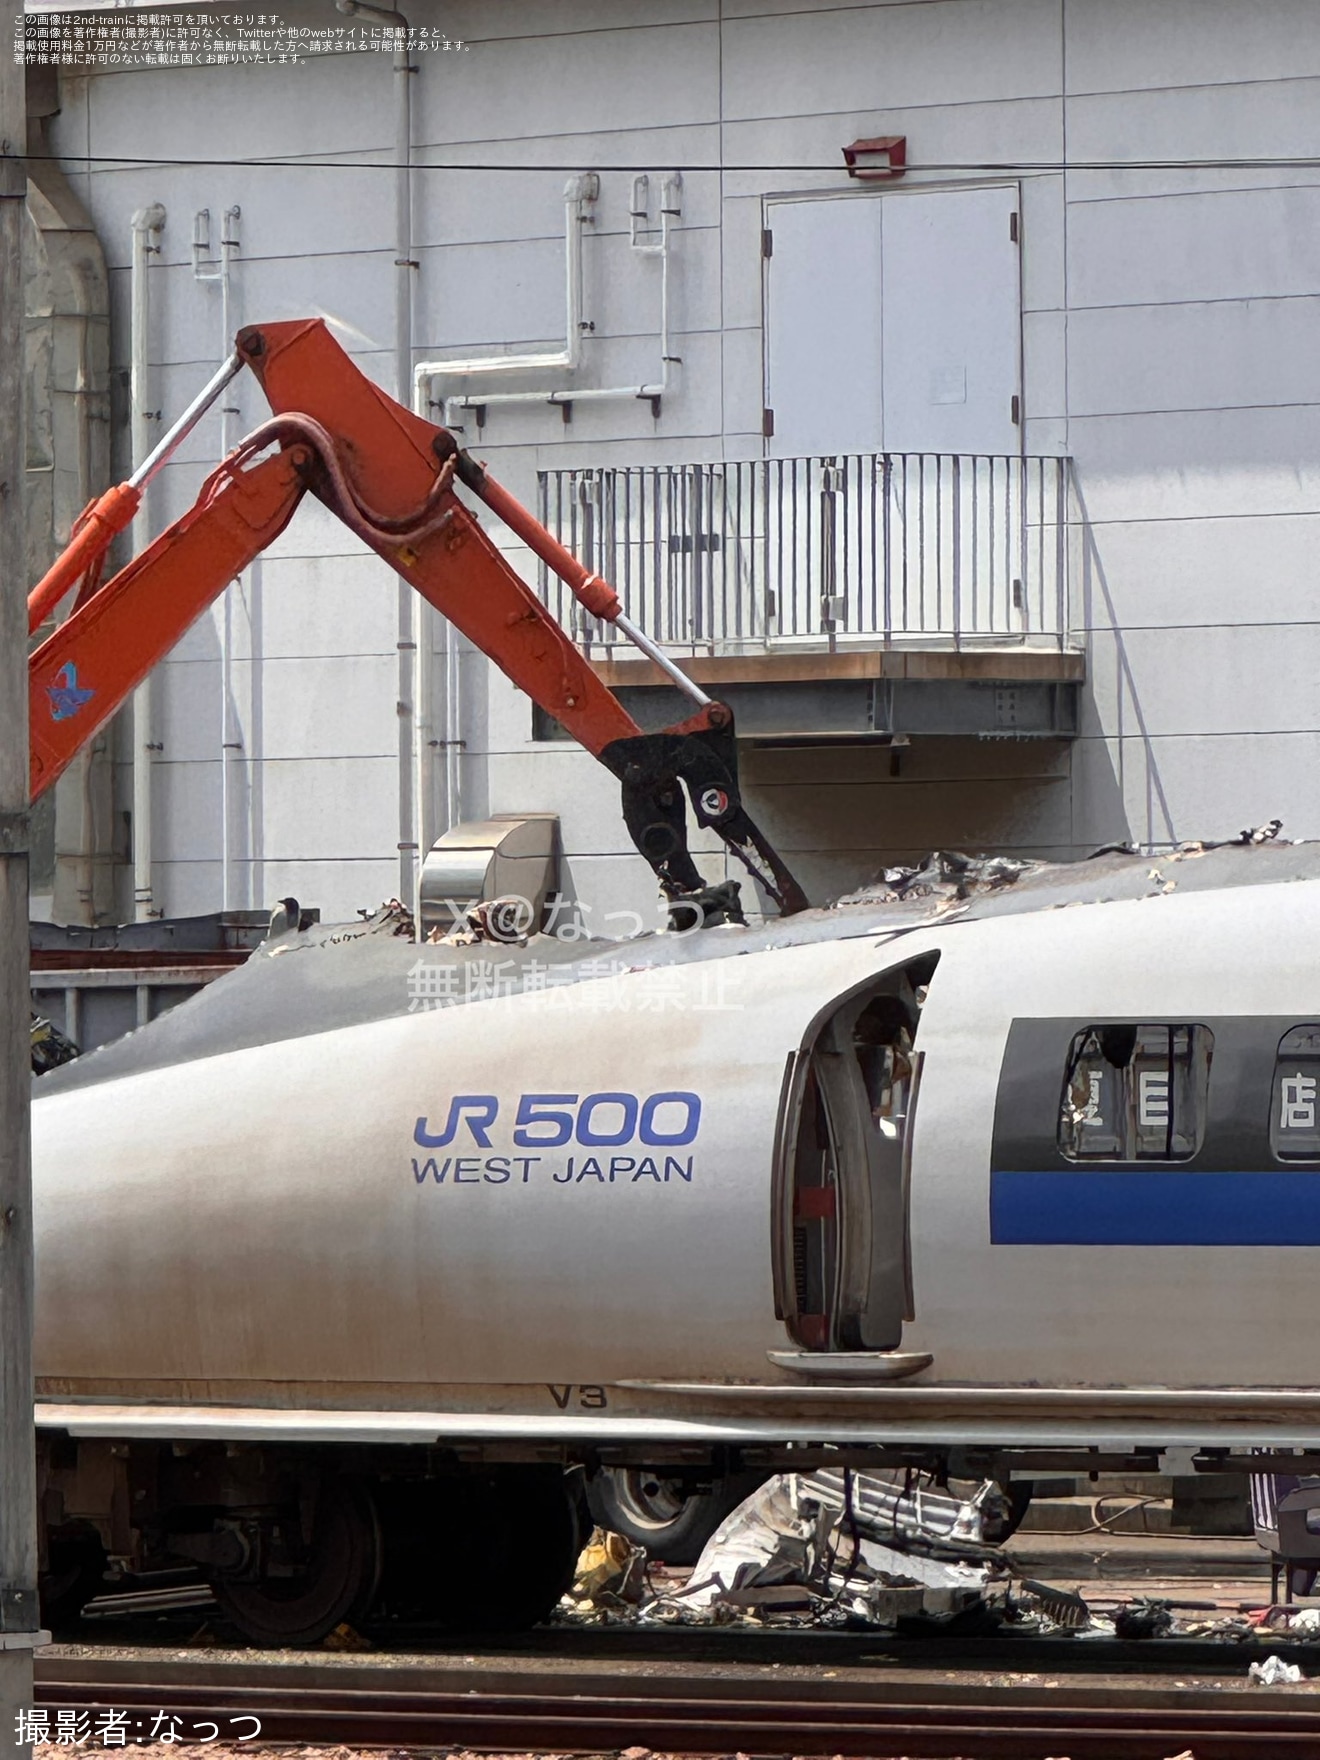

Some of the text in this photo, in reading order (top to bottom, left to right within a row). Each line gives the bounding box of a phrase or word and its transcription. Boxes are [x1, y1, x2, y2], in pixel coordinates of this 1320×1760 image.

[413, 1091, 702, 1149] JR 500
[411, 1155, 694, 1184] WEST JAPAN
[545, 1384, 608, 1409] V3
